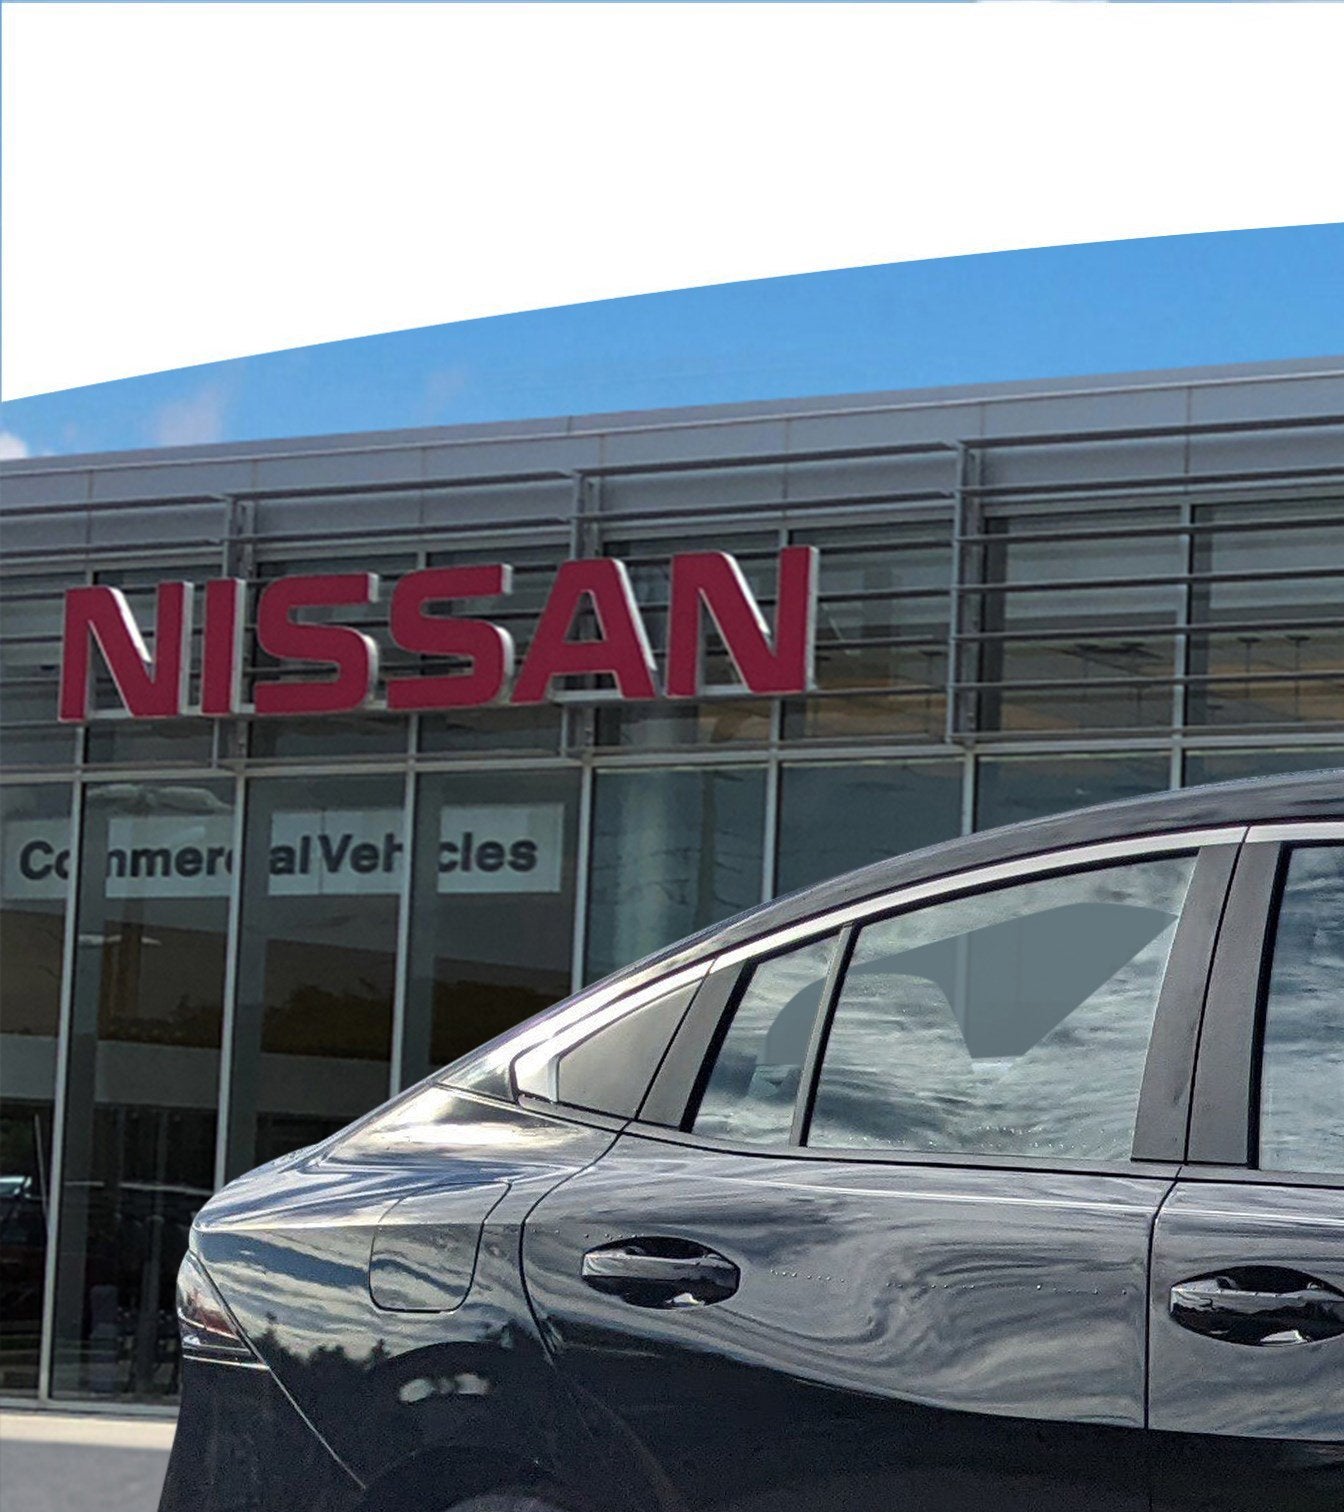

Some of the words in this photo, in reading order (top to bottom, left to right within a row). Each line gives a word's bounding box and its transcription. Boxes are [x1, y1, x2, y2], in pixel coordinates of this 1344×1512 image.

[57, 545, 820, 722] NISSAN
[19, 836, 312, 880] Comeral
[318, 832, 539, 874] Vehcles
